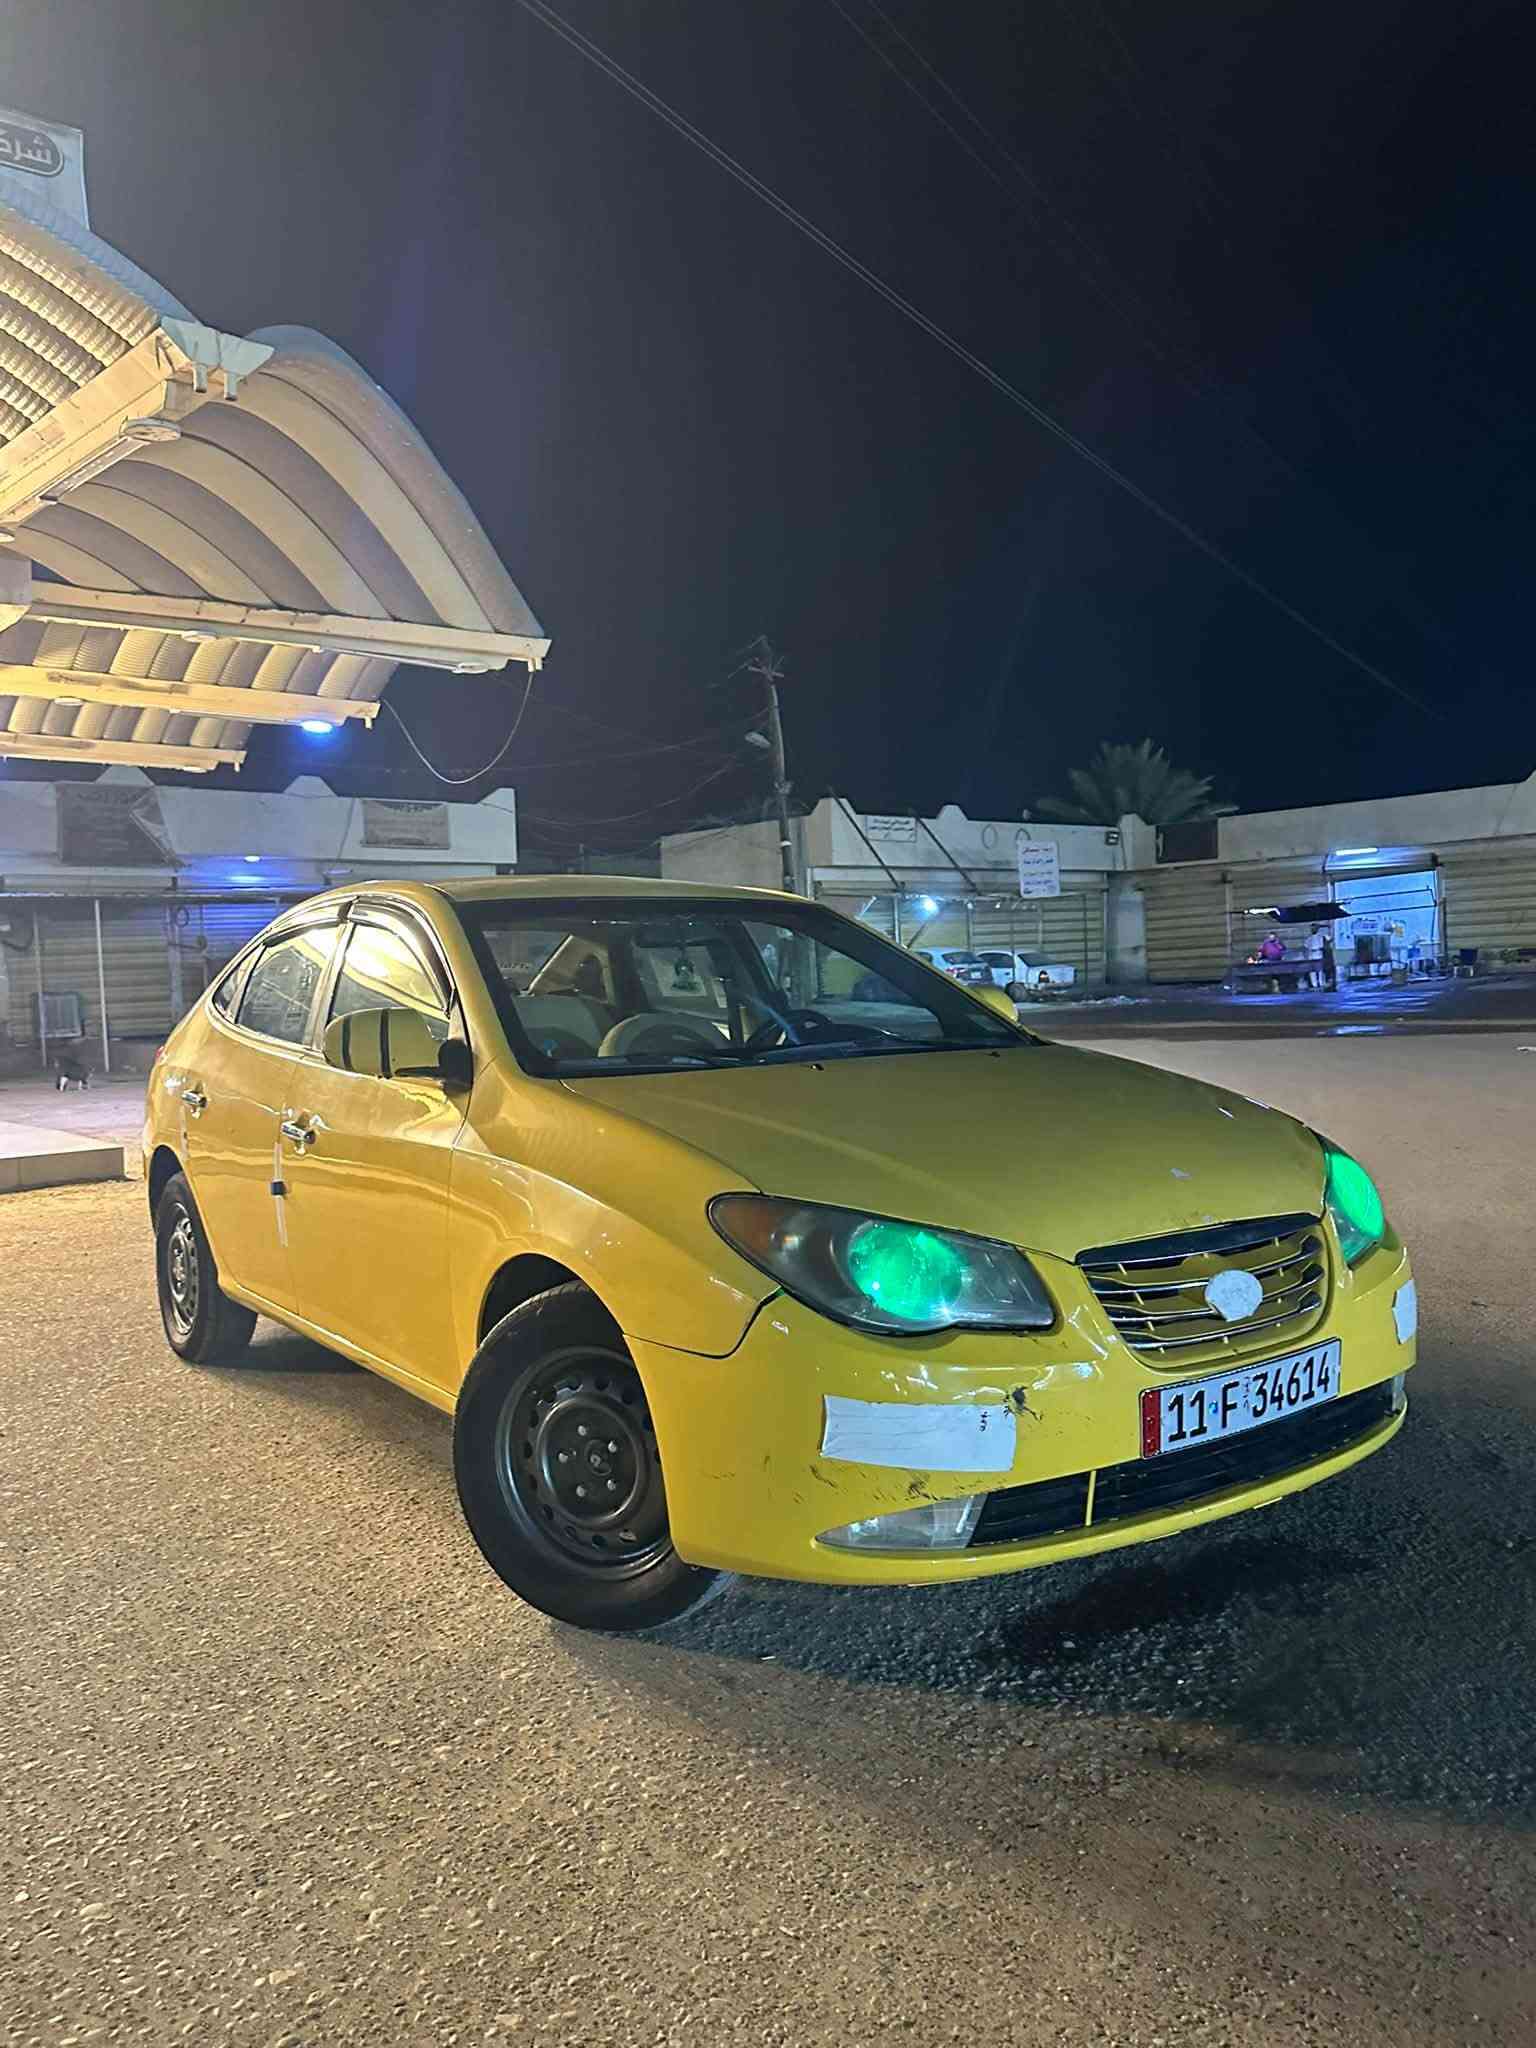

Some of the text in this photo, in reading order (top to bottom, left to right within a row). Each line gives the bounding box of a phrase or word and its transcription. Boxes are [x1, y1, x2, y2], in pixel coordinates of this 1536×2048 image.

[0, 128, 53, 164] شرك
[1167, 1388, 1208, 1443] 11
[1221, 1380, 1240, 1429] F
[1251, 1350, 1331, 1419] 34614
